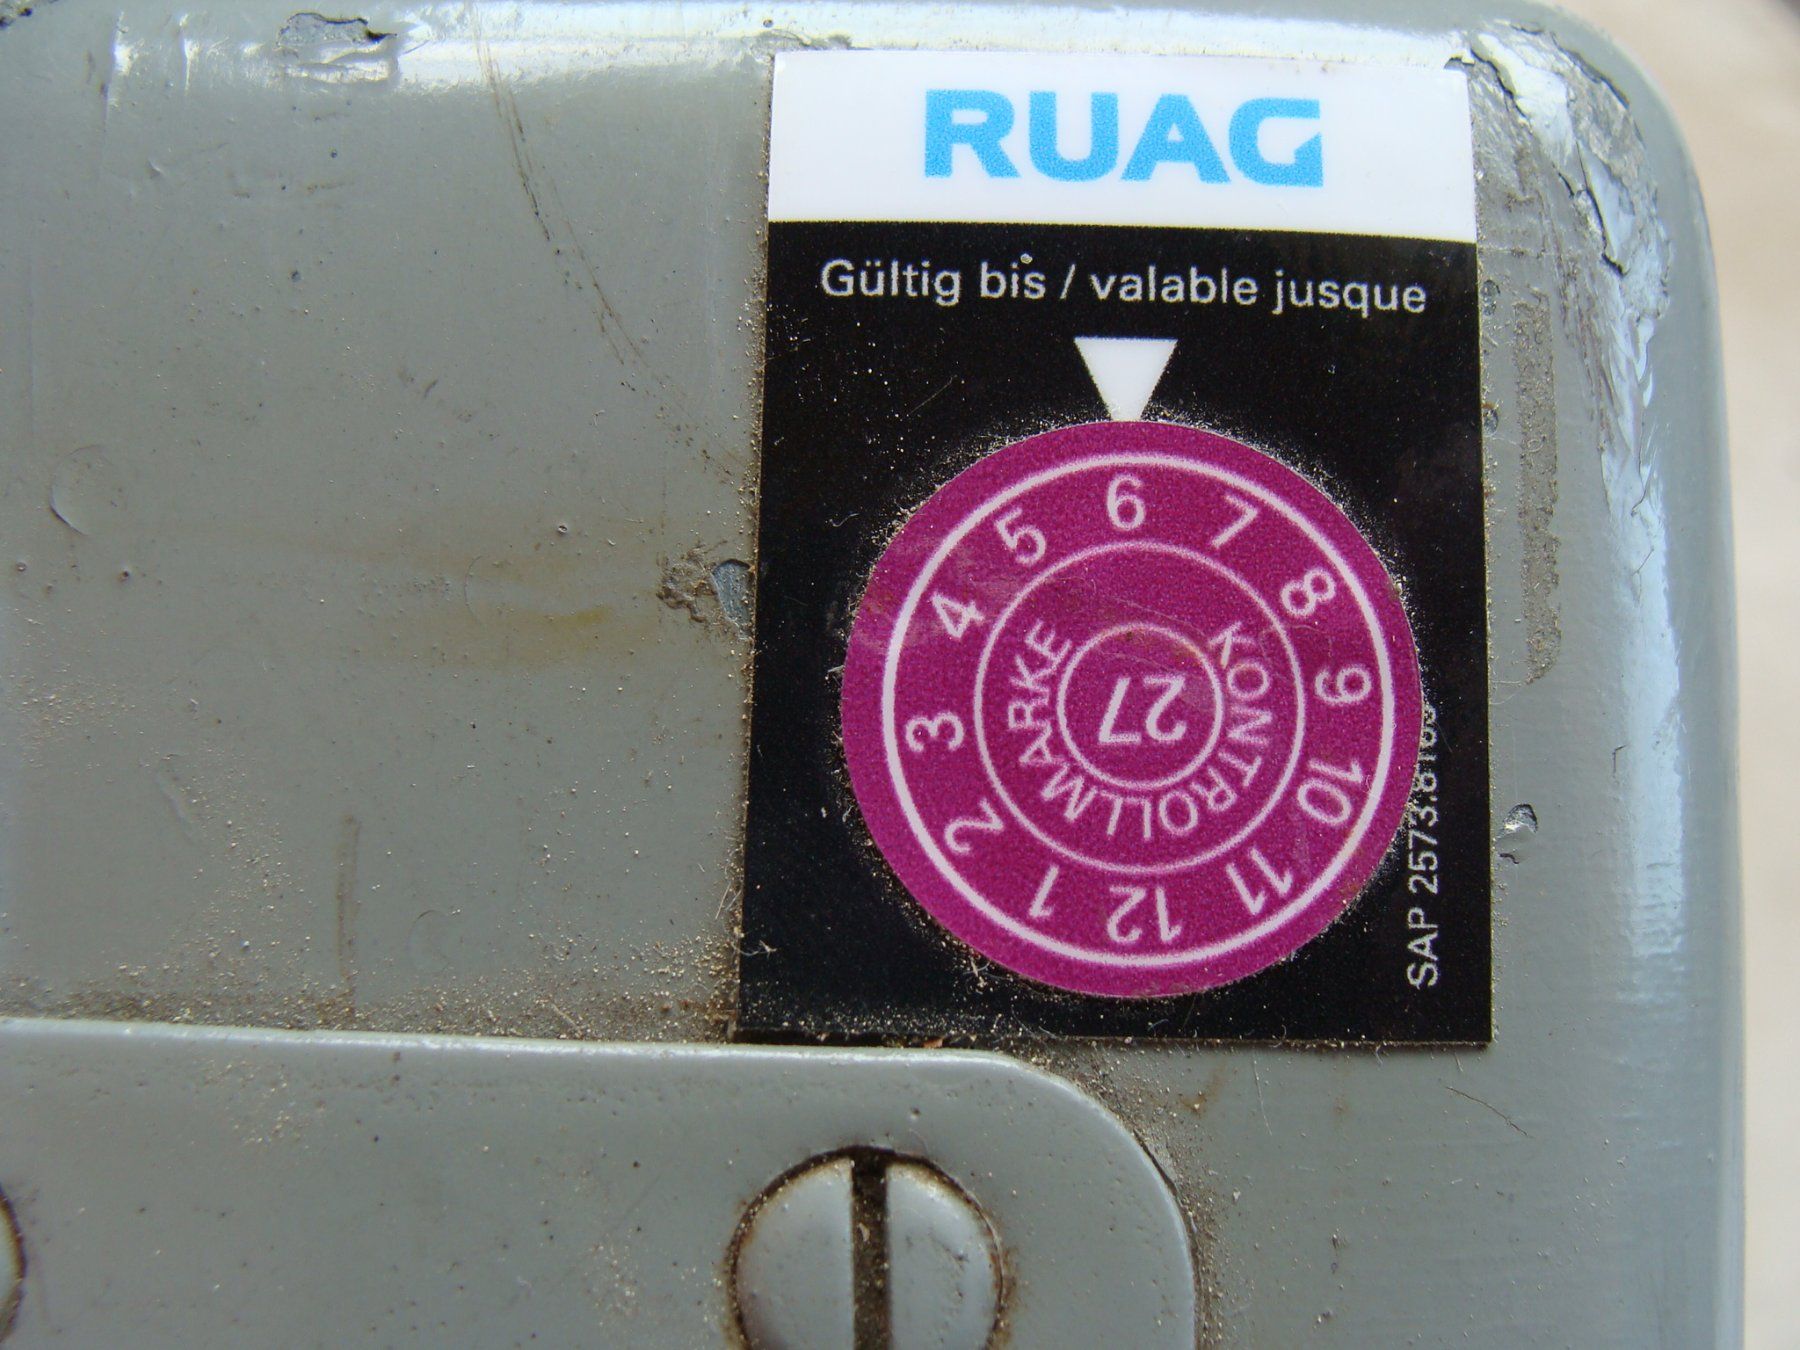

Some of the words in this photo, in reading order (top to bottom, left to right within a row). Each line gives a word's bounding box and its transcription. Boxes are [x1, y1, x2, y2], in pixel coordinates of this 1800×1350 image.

[925, 90, 1323, 187] RUAG
[822, 260, 960, 306] Gültig
[981, 260, 1045, 299] bis
[1061, 264, 1075, 298] /
[1091, 266, 1257, 304] valable
[1273, 270, 1425, 318] jusque
[1106, 474, 1145, 531] 6
[1212, 495, 1259, 548] 7
[996, 507, 1046, 564] 5
[932, 592, 985, 638] 4
[1281, 568, 1336, 616] 8
[1099, 675, 1186, 744] 27
[1315, 667, 1371, 705] 9
[906, 712, 964, 752] 3
[1008, 620, 1272, 840] KONTROLLMARKE
[1298, 757, 1364, 827] 10
[944, 799, 1003, 856] 2
[1030, 867, 1058, 918] 1
[1225, 849, 1294, 917] 11
[1107, 886, 1181, 943] 12
[1407, 908, 1438, 989] SAP
